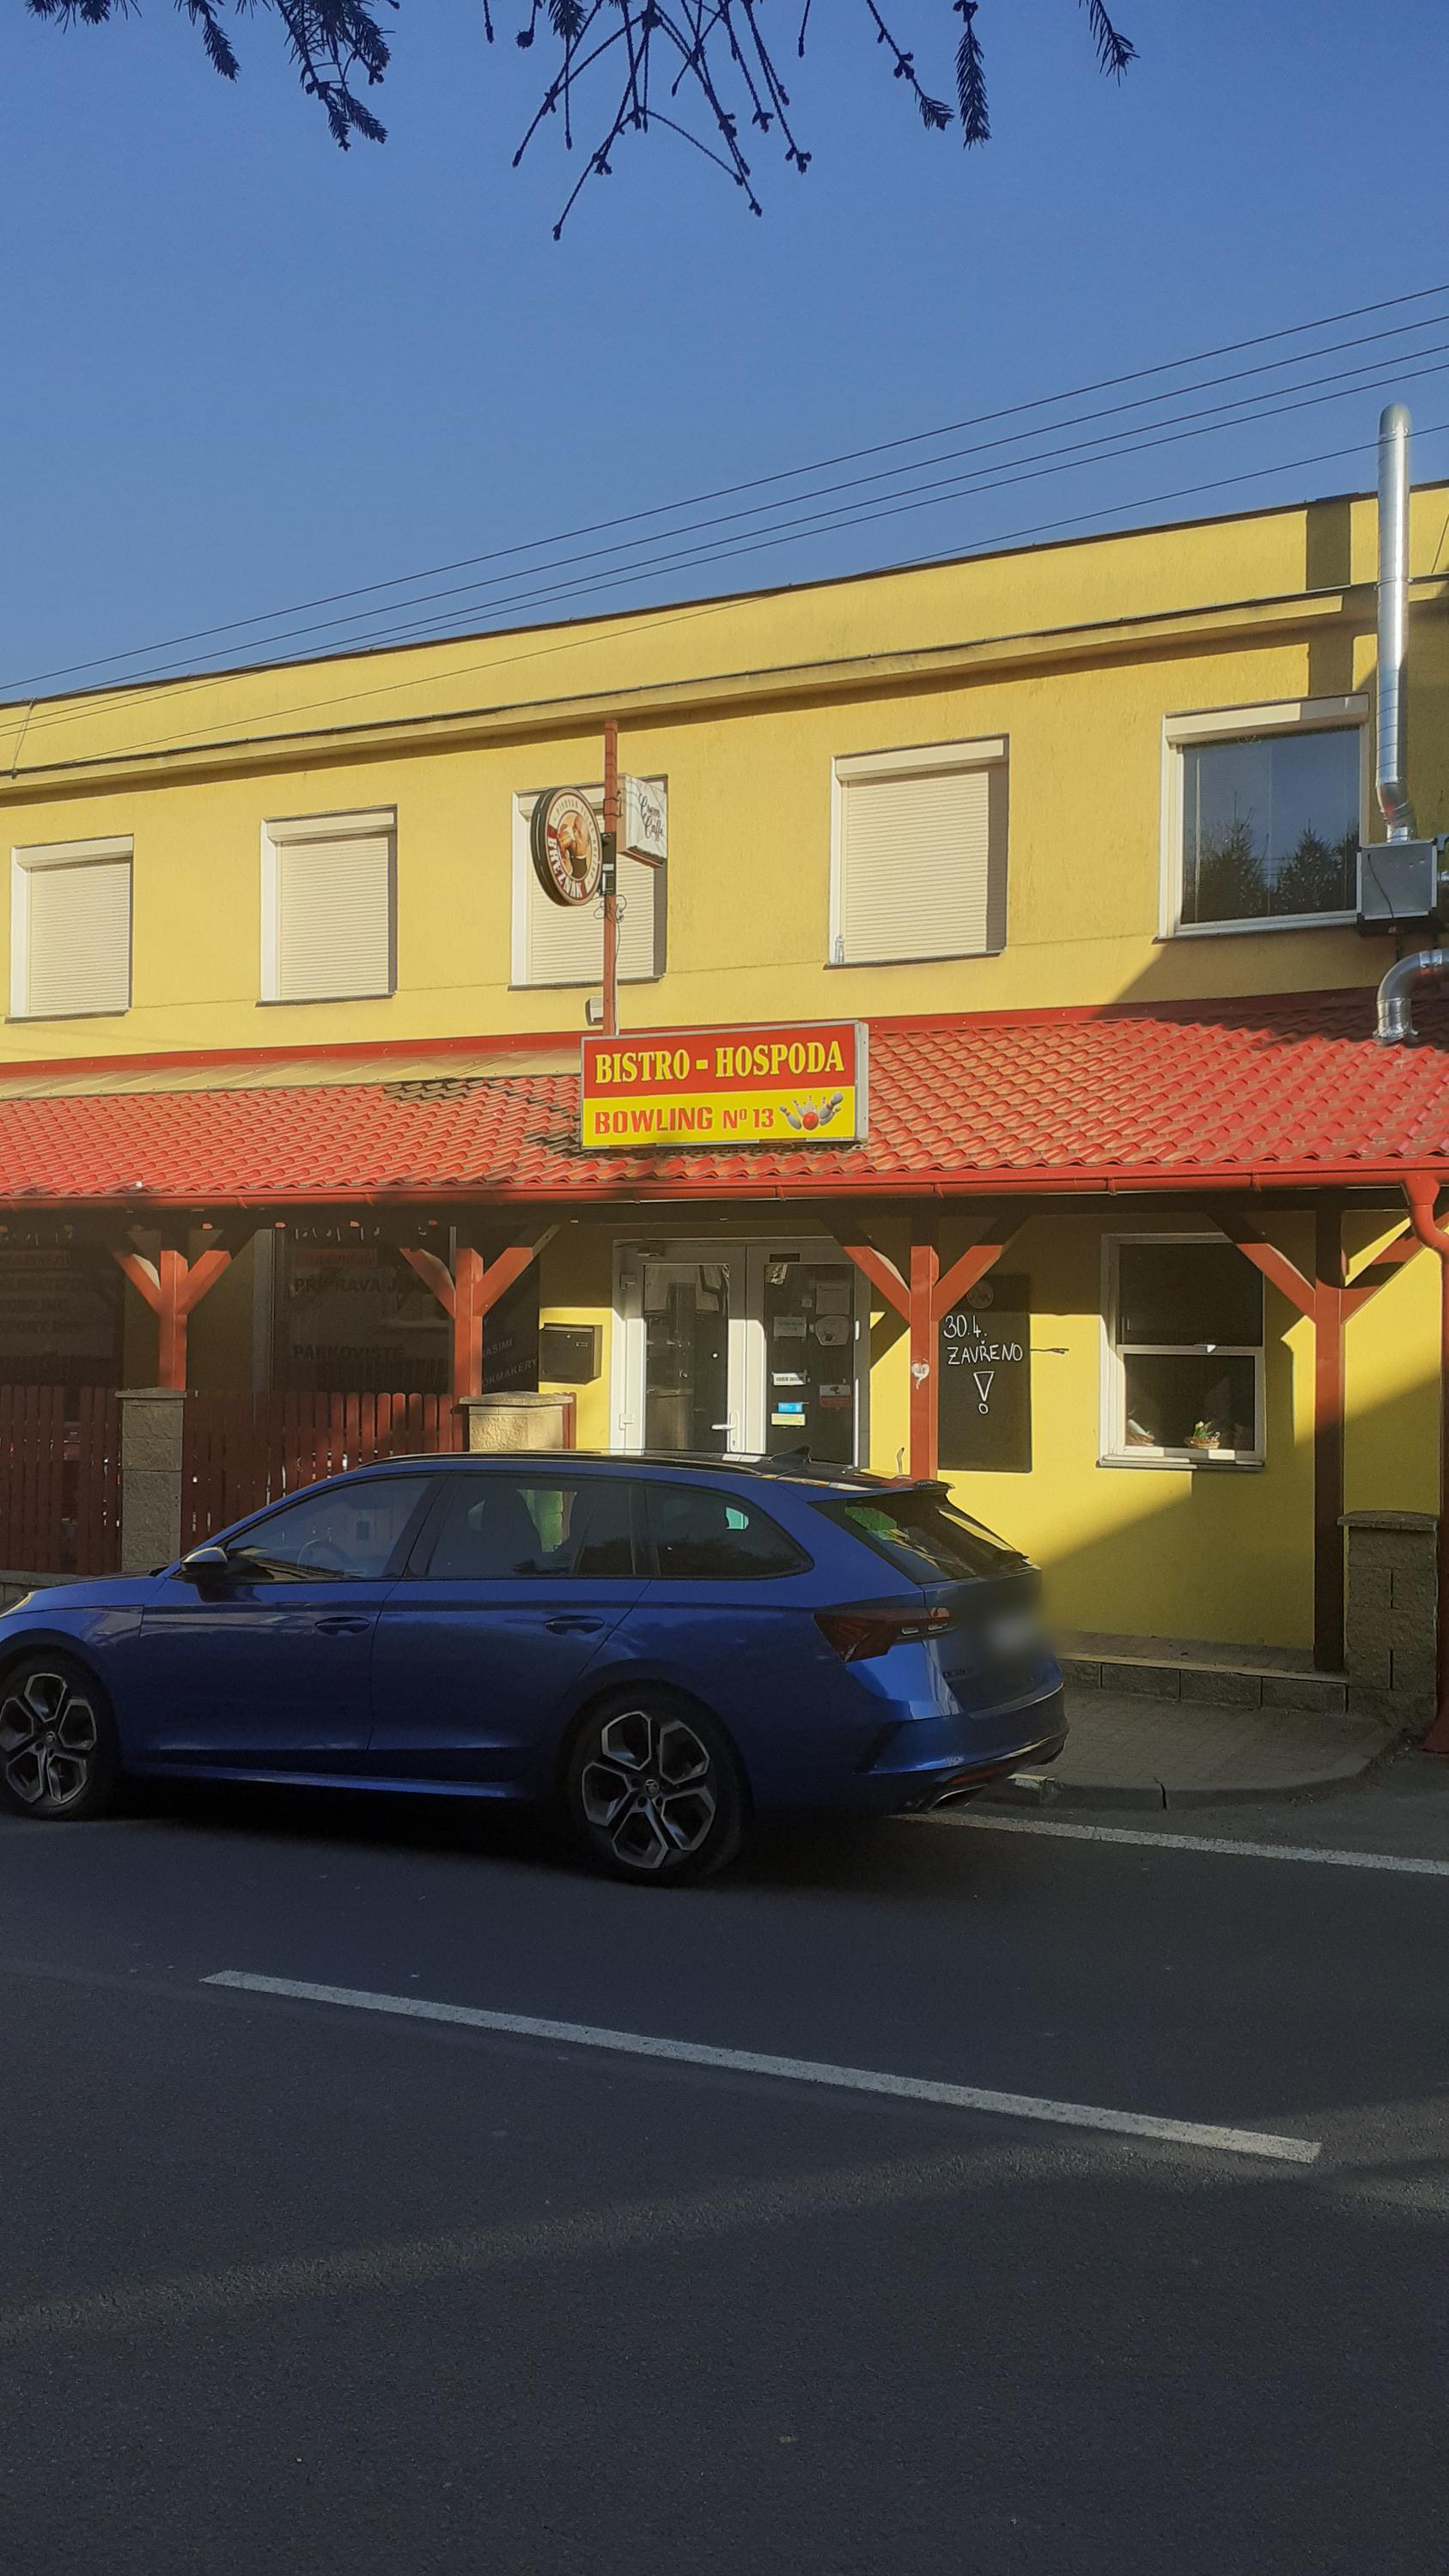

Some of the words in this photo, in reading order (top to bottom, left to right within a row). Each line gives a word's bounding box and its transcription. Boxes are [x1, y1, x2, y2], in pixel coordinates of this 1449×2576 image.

[594, 1048, 691, 1084] BISTRO
[715, 1040, 845, 1078] HOSPODA
[594, 1106, 713, 1135] BOWLING
[752, 1108, 775, 1129] 13
[947, 1340, 1023, 1365] ZAVŘENO
[482, 1356, 538, 1388] OKMAKERY
